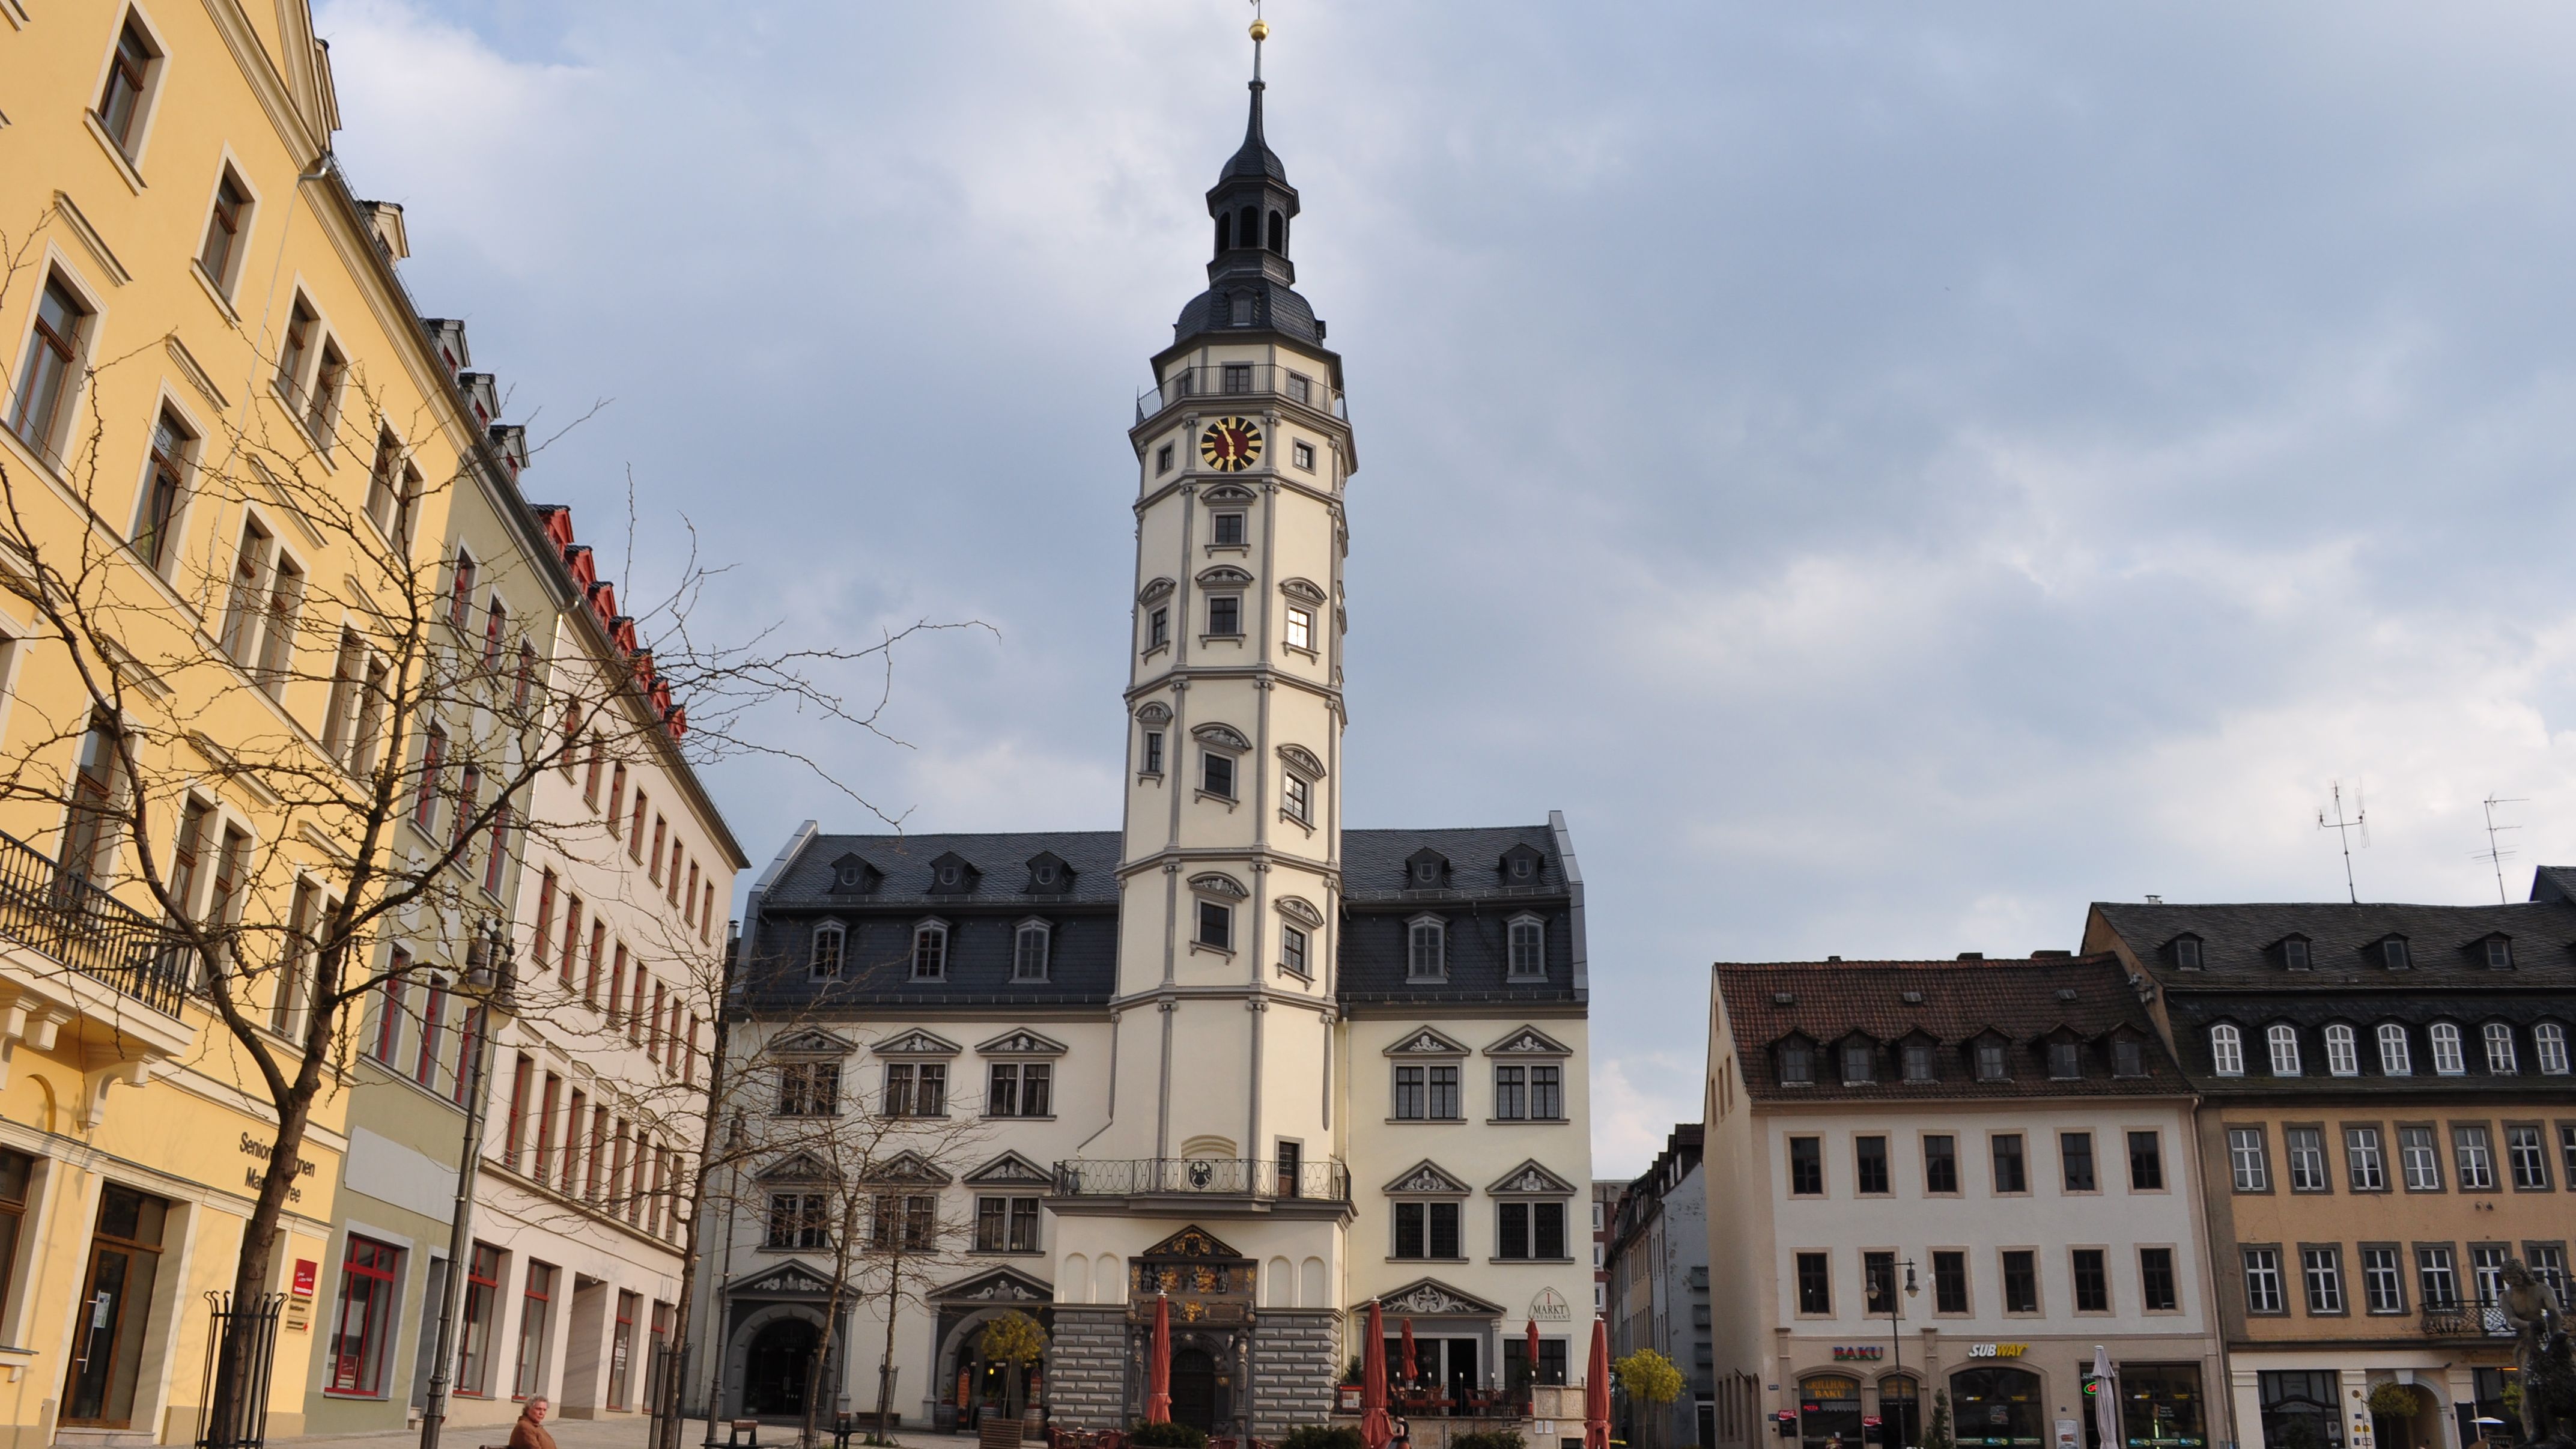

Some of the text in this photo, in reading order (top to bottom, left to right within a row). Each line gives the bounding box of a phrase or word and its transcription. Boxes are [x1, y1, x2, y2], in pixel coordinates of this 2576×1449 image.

[1533, 1305, 1565, 1314] MARKT
[1833, 1347, 1884, 1360] BAKU
[1968, 1343, 2029, 1357] SUBWAY
[1815, 1390, 1844, 1399] BAKU
